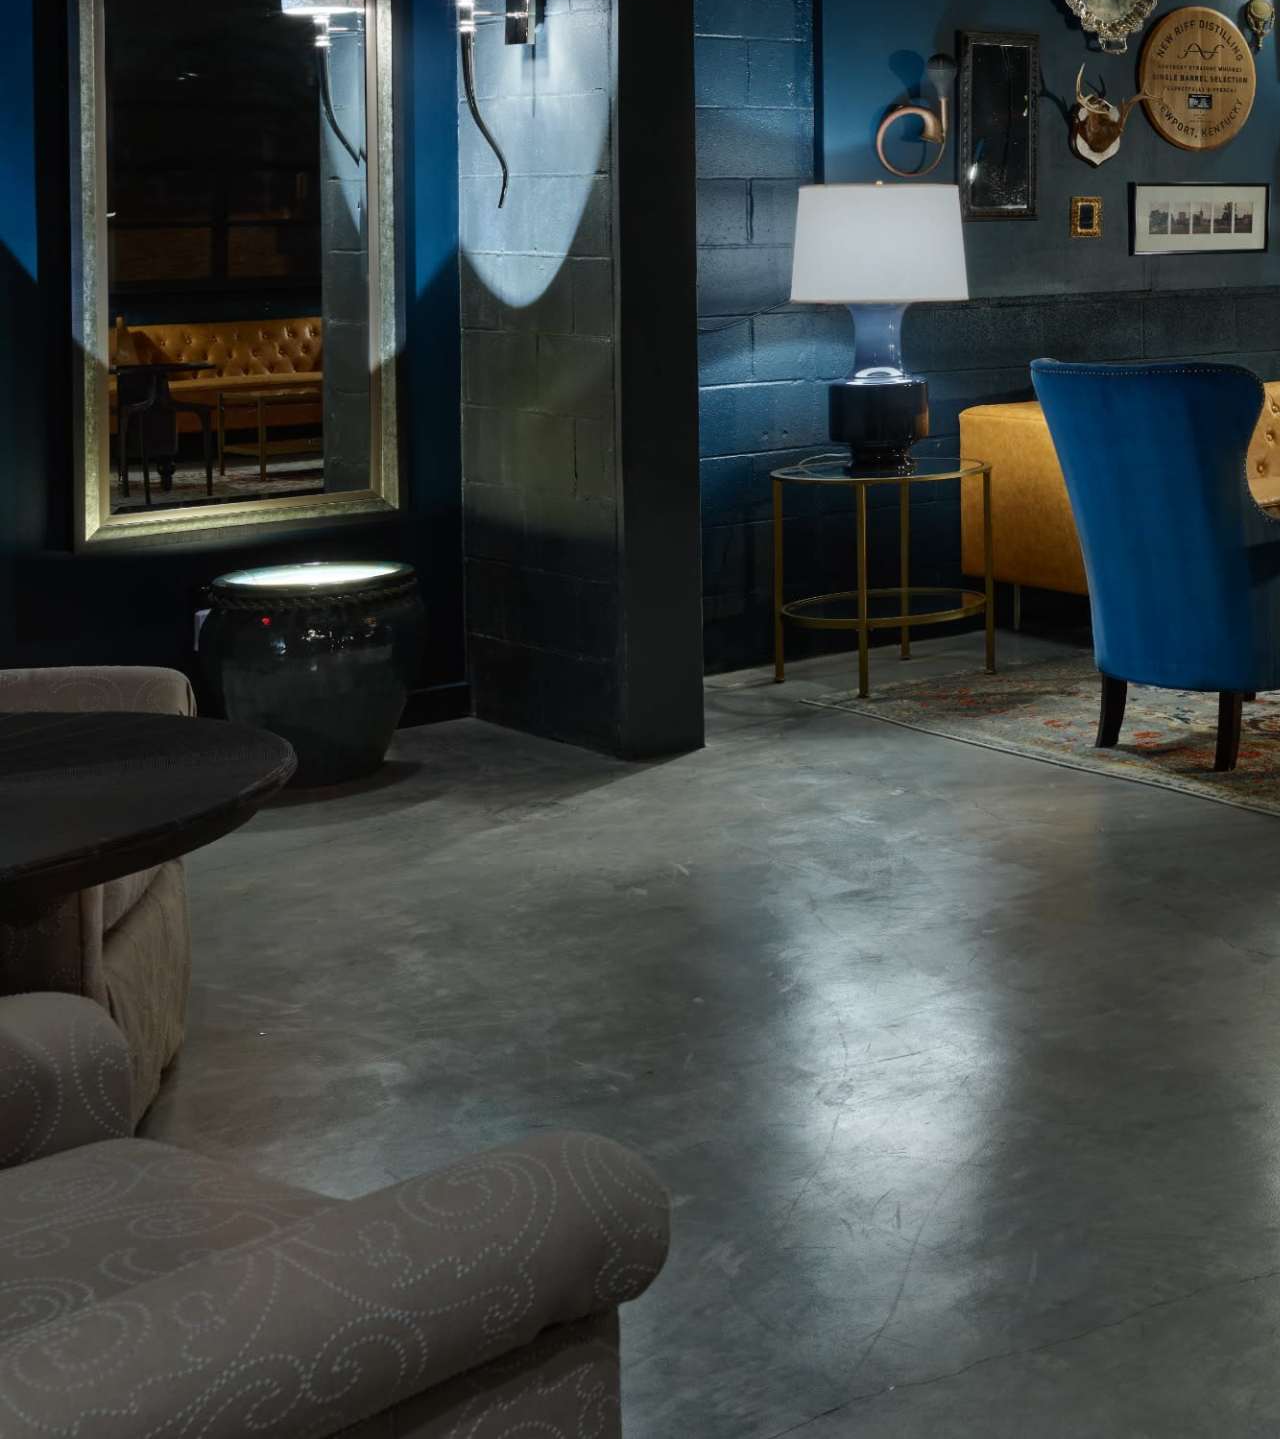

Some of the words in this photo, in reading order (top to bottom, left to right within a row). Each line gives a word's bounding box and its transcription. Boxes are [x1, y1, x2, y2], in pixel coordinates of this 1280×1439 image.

[1157, 34, 1174, 58] NEW
[1174, 20, 1196, 35] RIFF
[1199, 19, 1243, 61] DISTILLING
[1180, 74, 1207, 82] BARREL
[1210, 75, 1248, 84] SELECTION
[1158, 101, 1198, 138] EWPORT,
[1201, 98, 1243, 138] KENTUCKY
